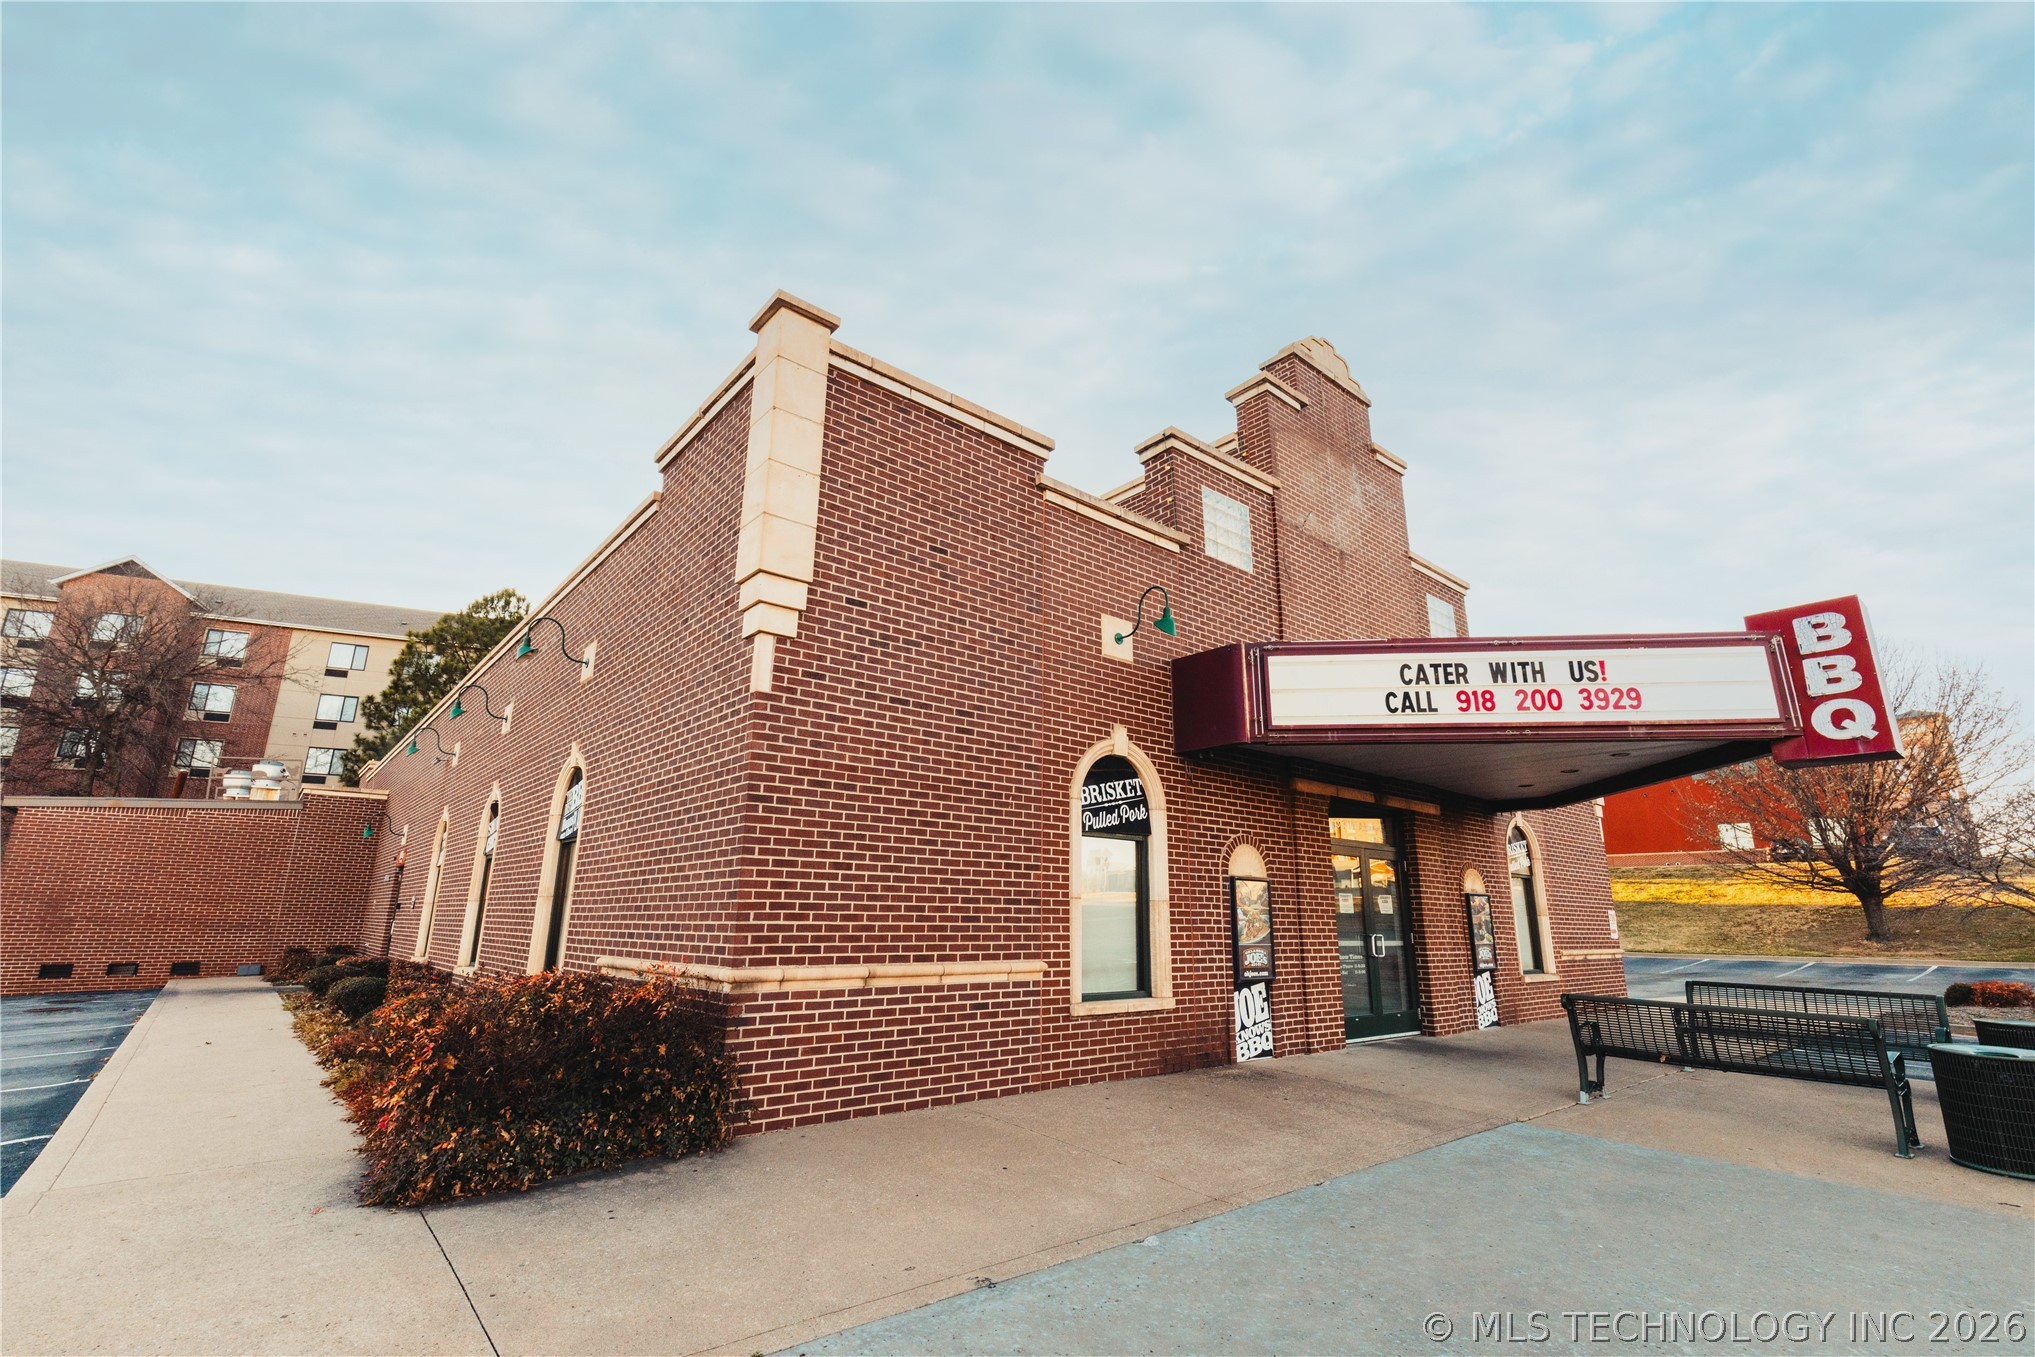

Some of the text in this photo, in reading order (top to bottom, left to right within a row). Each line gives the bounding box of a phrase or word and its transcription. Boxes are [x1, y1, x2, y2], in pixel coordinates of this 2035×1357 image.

[1400, 660, 1608, 686] CATER WITH US!
[1792, 612, 1879, 740] BBQ
[1385, 687, 1642, 713] CALL 918 200 3929
[1082, 778, 1143, 805] BRISKET
[1083, 804, 1148, 831] Pulled Pork
[1236, 1032, 1274, 1062] BBQ
